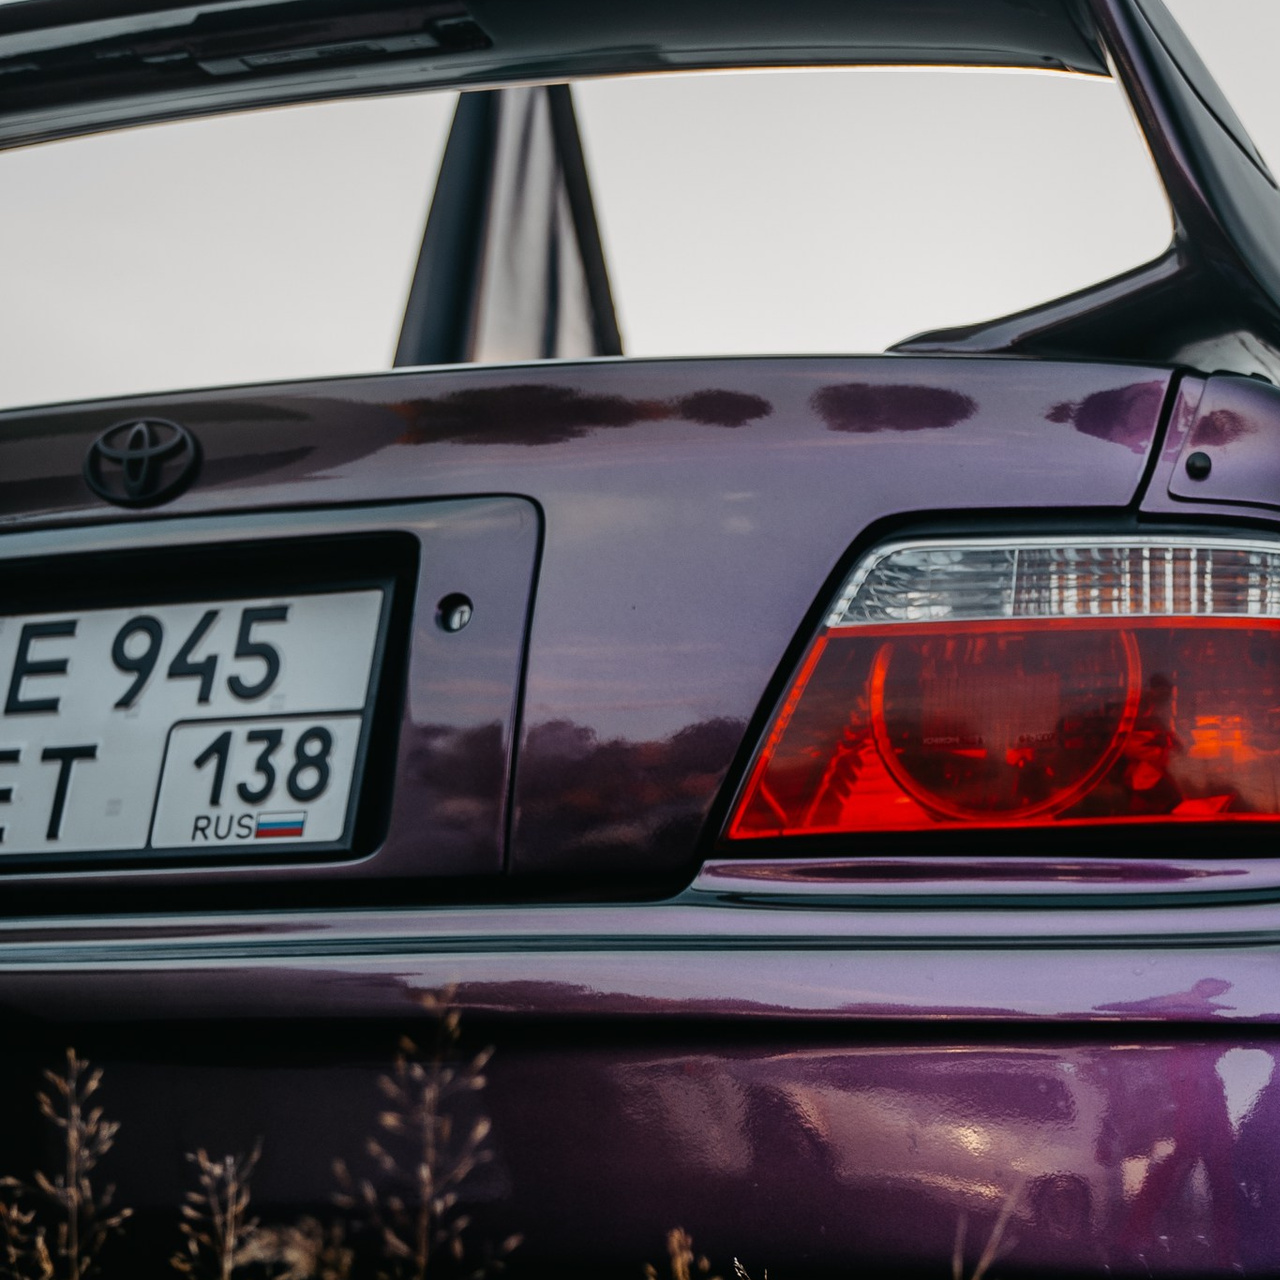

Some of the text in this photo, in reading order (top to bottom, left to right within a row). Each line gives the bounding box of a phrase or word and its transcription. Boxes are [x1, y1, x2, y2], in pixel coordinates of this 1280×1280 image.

[4, 604, 292, 715] E 945
[194, 726, 333, 807] 138
[191, 814, 254, 842] RUS
